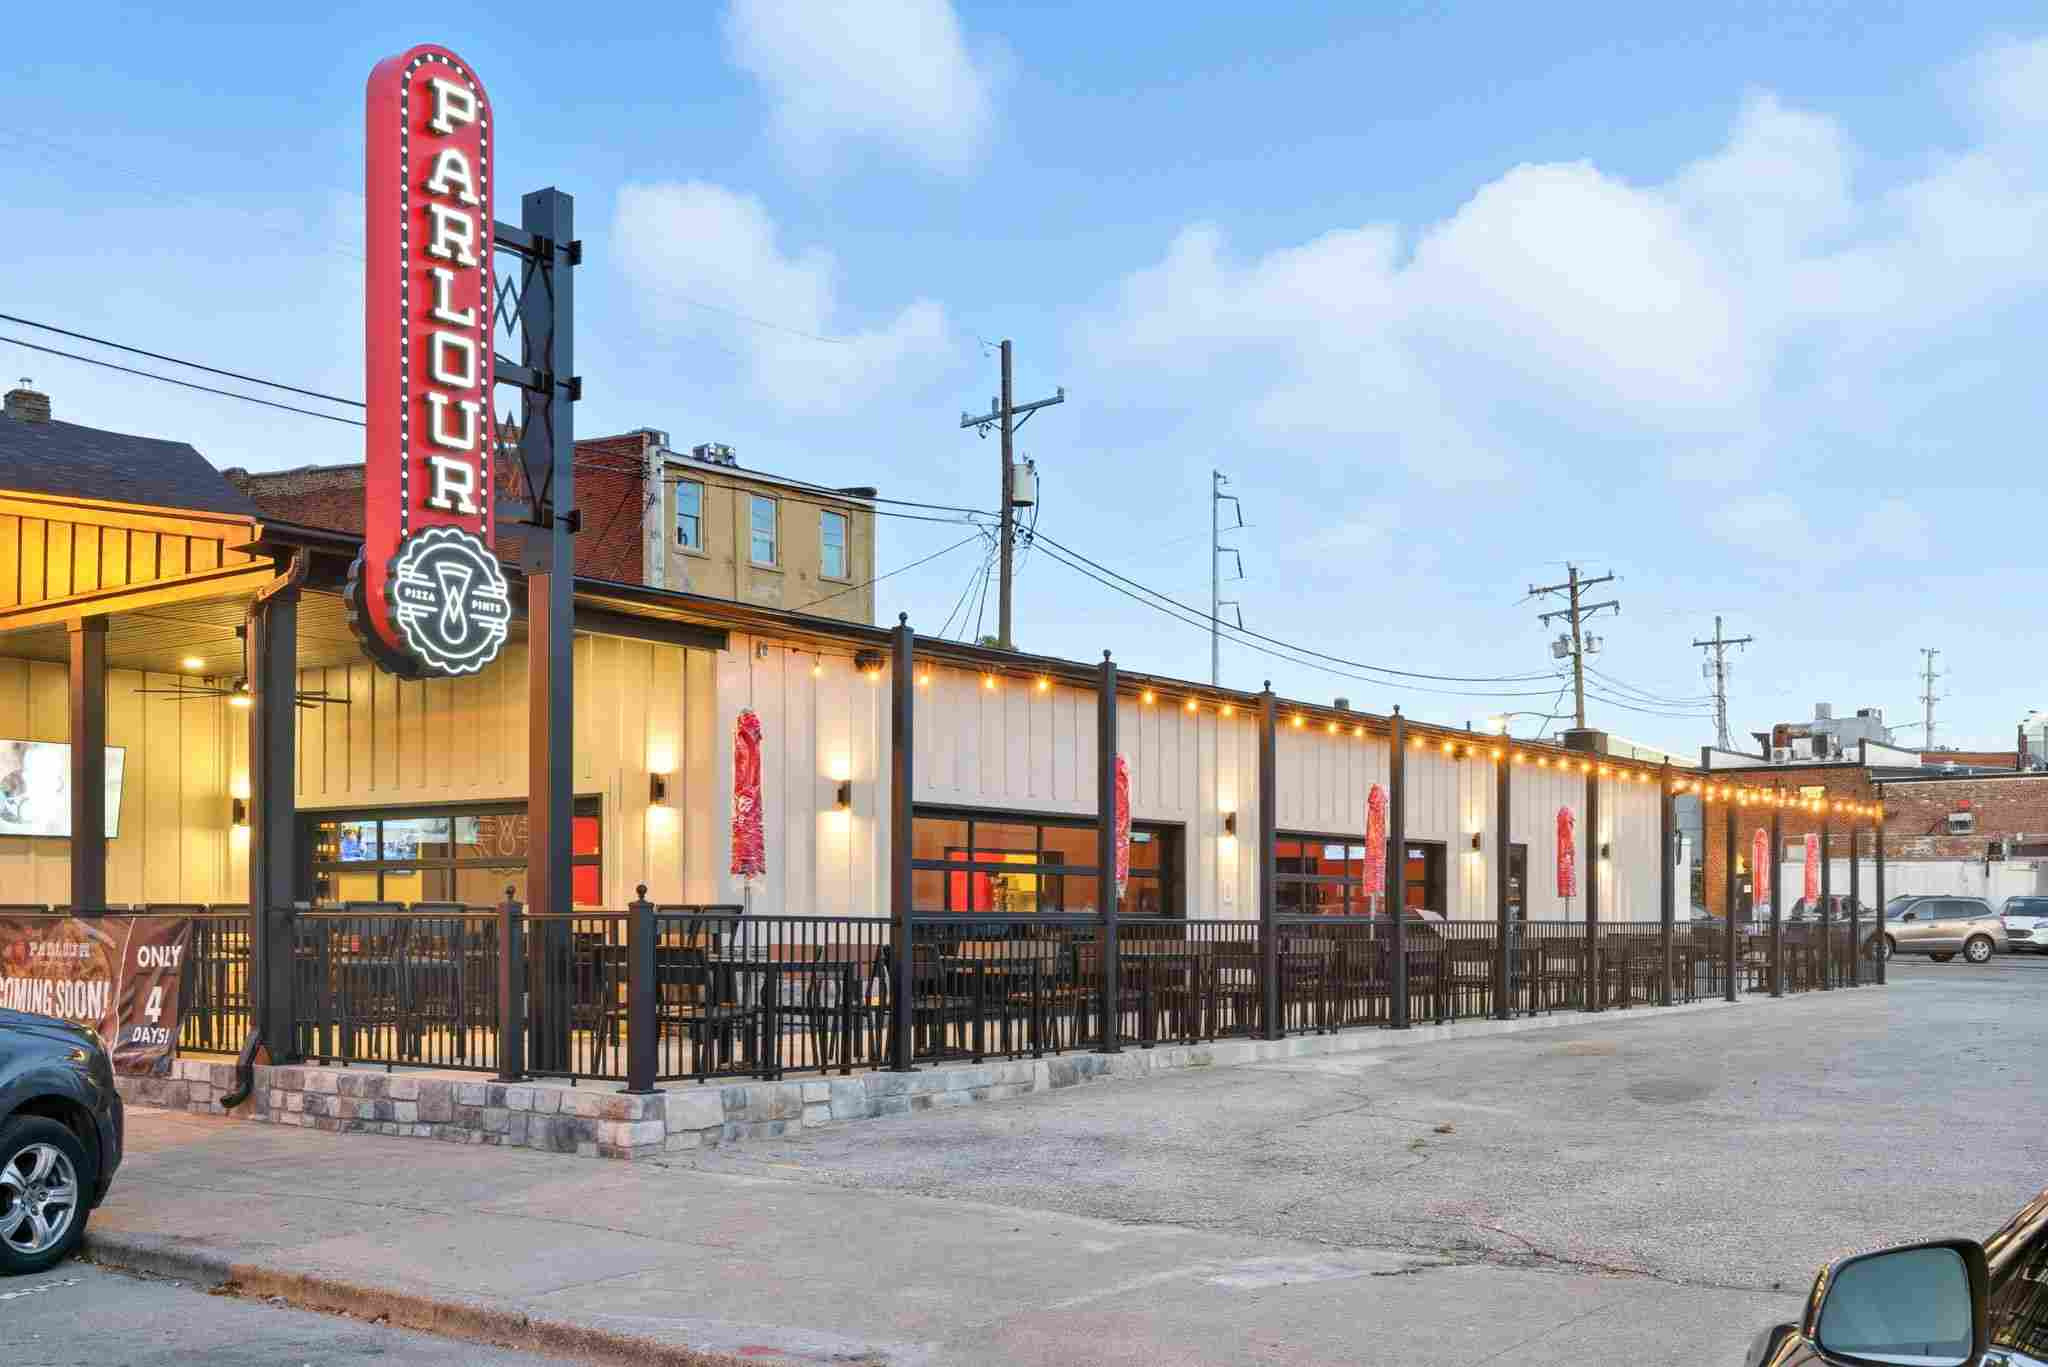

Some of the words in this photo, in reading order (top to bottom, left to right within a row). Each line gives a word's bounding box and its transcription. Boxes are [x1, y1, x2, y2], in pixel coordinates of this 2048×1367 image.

[427, 78, 479, 515] PARLOUR
[404, 588, 436, 602] PIZZA
[471, 599, 502, 614] PINTS
[137, 945, 182, 968] ONLY
[56, 979, 111, 1020] SOON!
[144, 985, 163, 1022] 4
[131, 1027, 170, 1044] DAYS!
